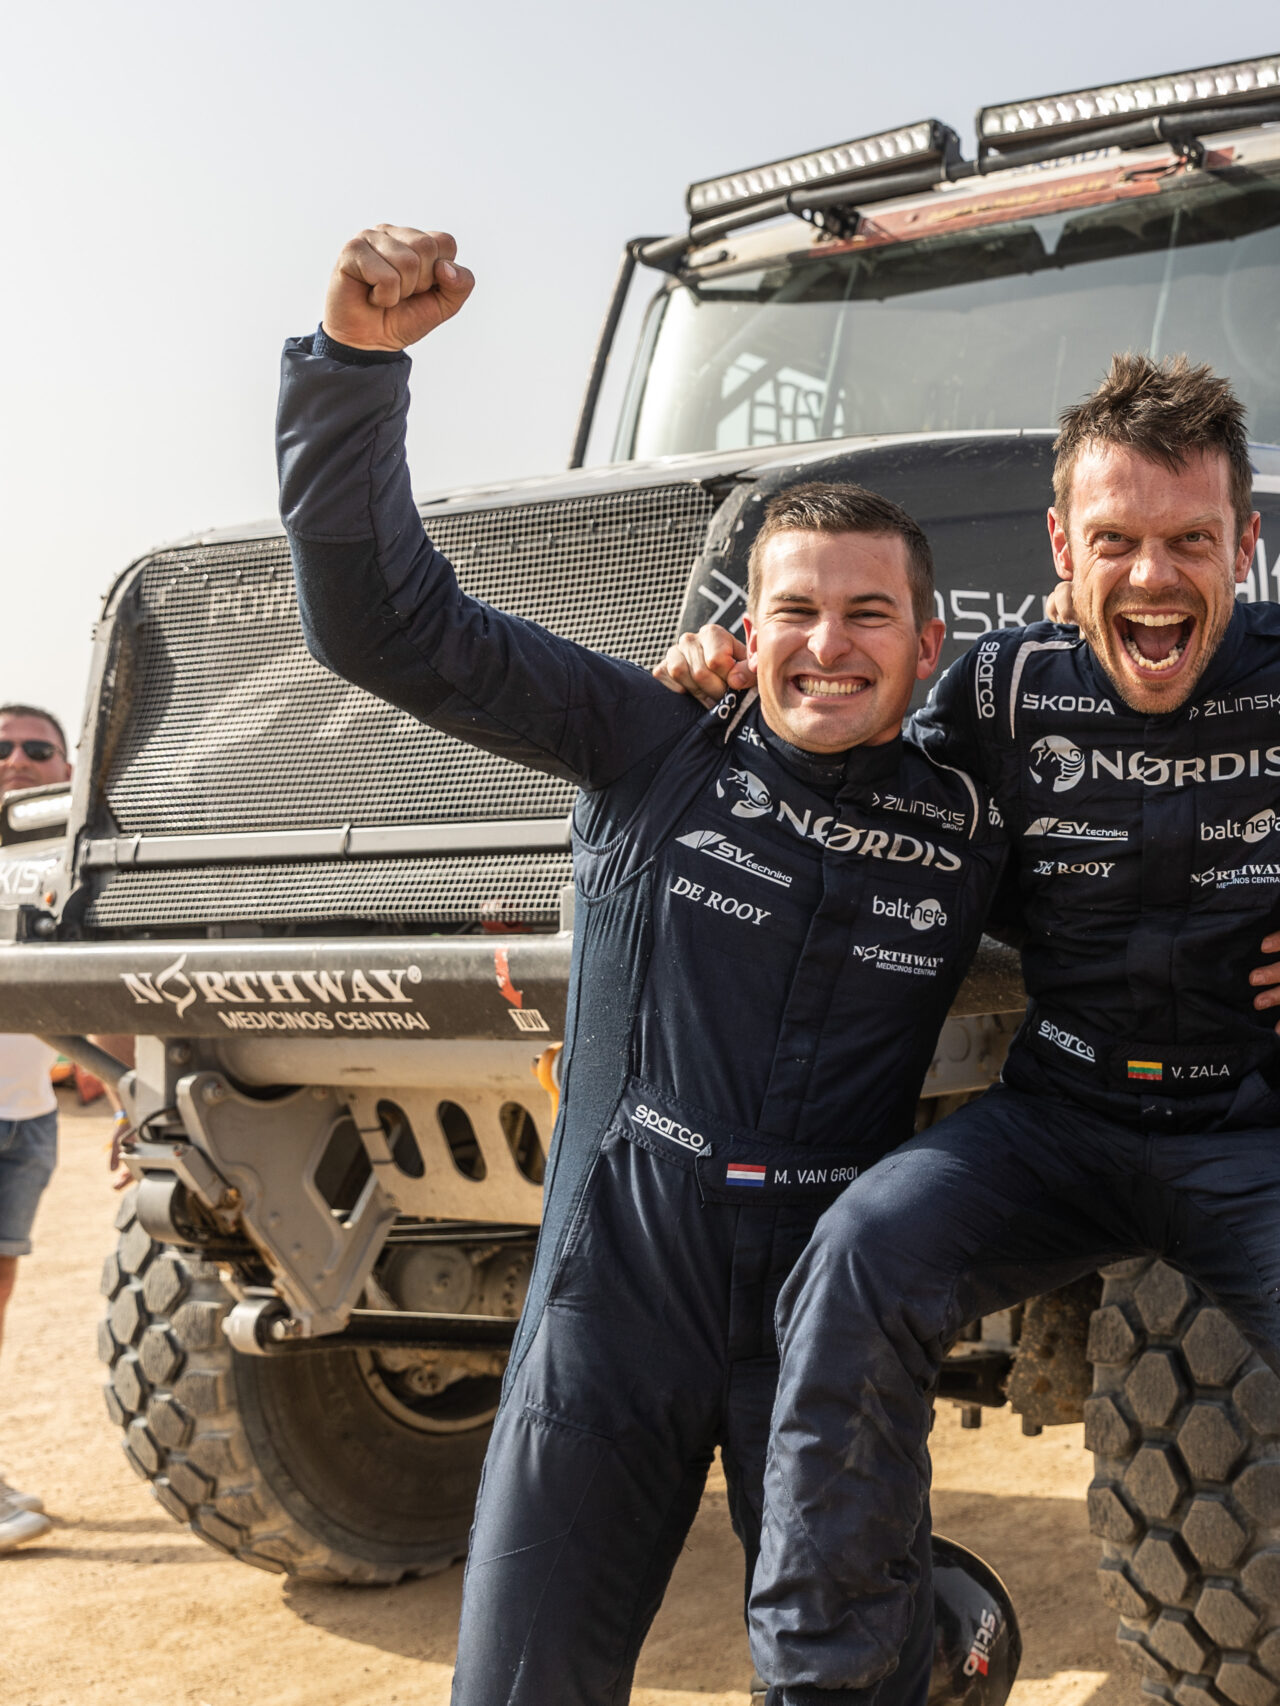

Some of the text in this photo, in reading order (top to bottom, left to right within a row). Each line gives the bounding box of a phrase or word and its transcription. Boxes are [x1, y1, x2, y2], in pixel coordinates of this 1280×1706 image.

[977, 641, 1000, 718] sparco
[1056, 862, 1115, 878] ROOY
[670, 876, 771, 925] DE ROOY
[872, 895, 947, 928] baltneta
[217, 1011, 430, 1031] MEDICINOS CENTRAI
[1039, 1020, 1095, 1060] sparco
[1171, 1064, 1230, 1078] V. ZALA
[633, 1104, 704, 1150] sparco
[774, 1169, 791, 1184] M.
[797, 1168, 826, 1184] VAN
